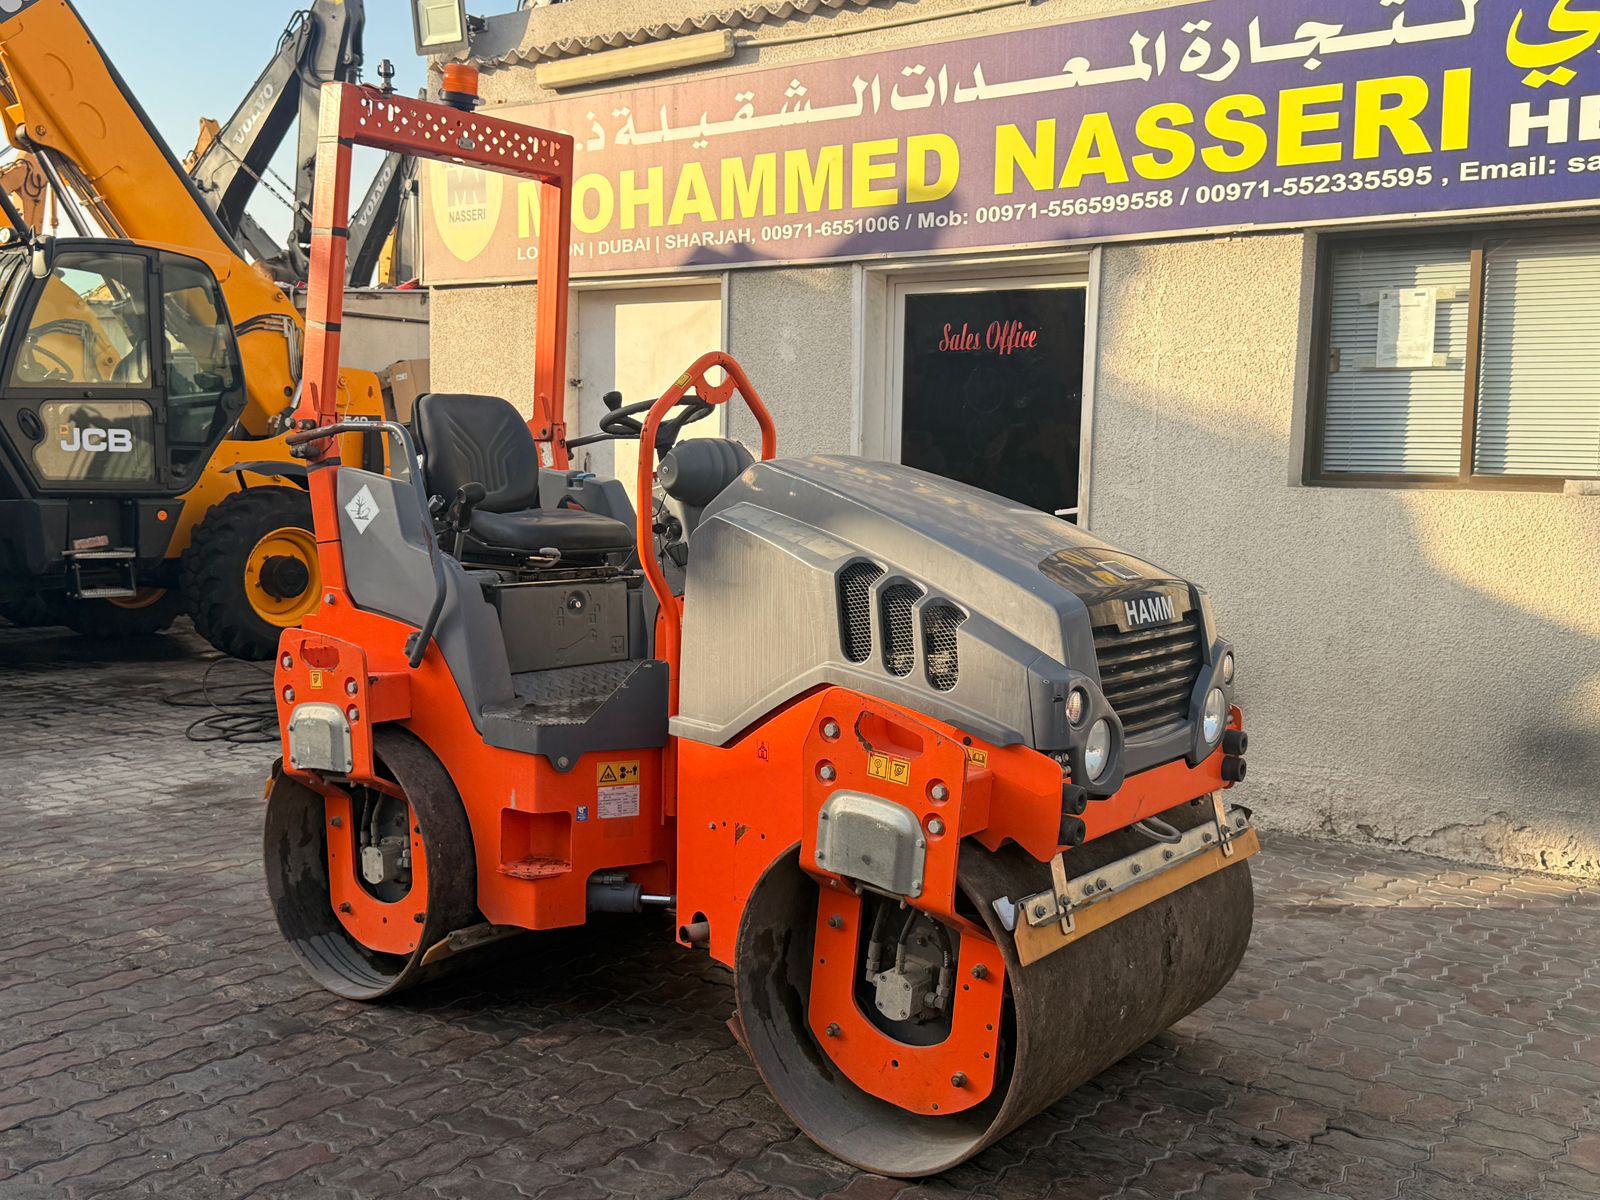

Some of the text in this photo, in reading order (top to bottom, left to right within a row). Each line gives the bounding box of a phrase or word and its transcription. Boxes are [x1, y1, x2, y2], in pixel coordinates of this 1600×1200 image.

[890, 31, 1166, 111] المعدات
[232, 84, 273, 144] VOLVO
[995, 67, 1472, 195] NASSERI
[359, 167, 391, 226] VOLVO
[449, 208, 486, 224] NASSERI
[518, 242, 584, 261] LON
[598, 237, 650, 256] DUBAI
[665, 229, 756, 249] SHARJAH,
[761, 215, 900, 241] 00971-6551006
[918, 210, 968, 229] Mob:
[975, 189, 1173, 223] 00971-556599558
[1196, 166, 1432, 203] 00971-552335595
[1460, 155, 1556, 182] Email:
[939, 320, 1038, 355] Sales Office
[60, 427, 132, 452] JCB
[1124, 595, 1176, 626] HAMM
